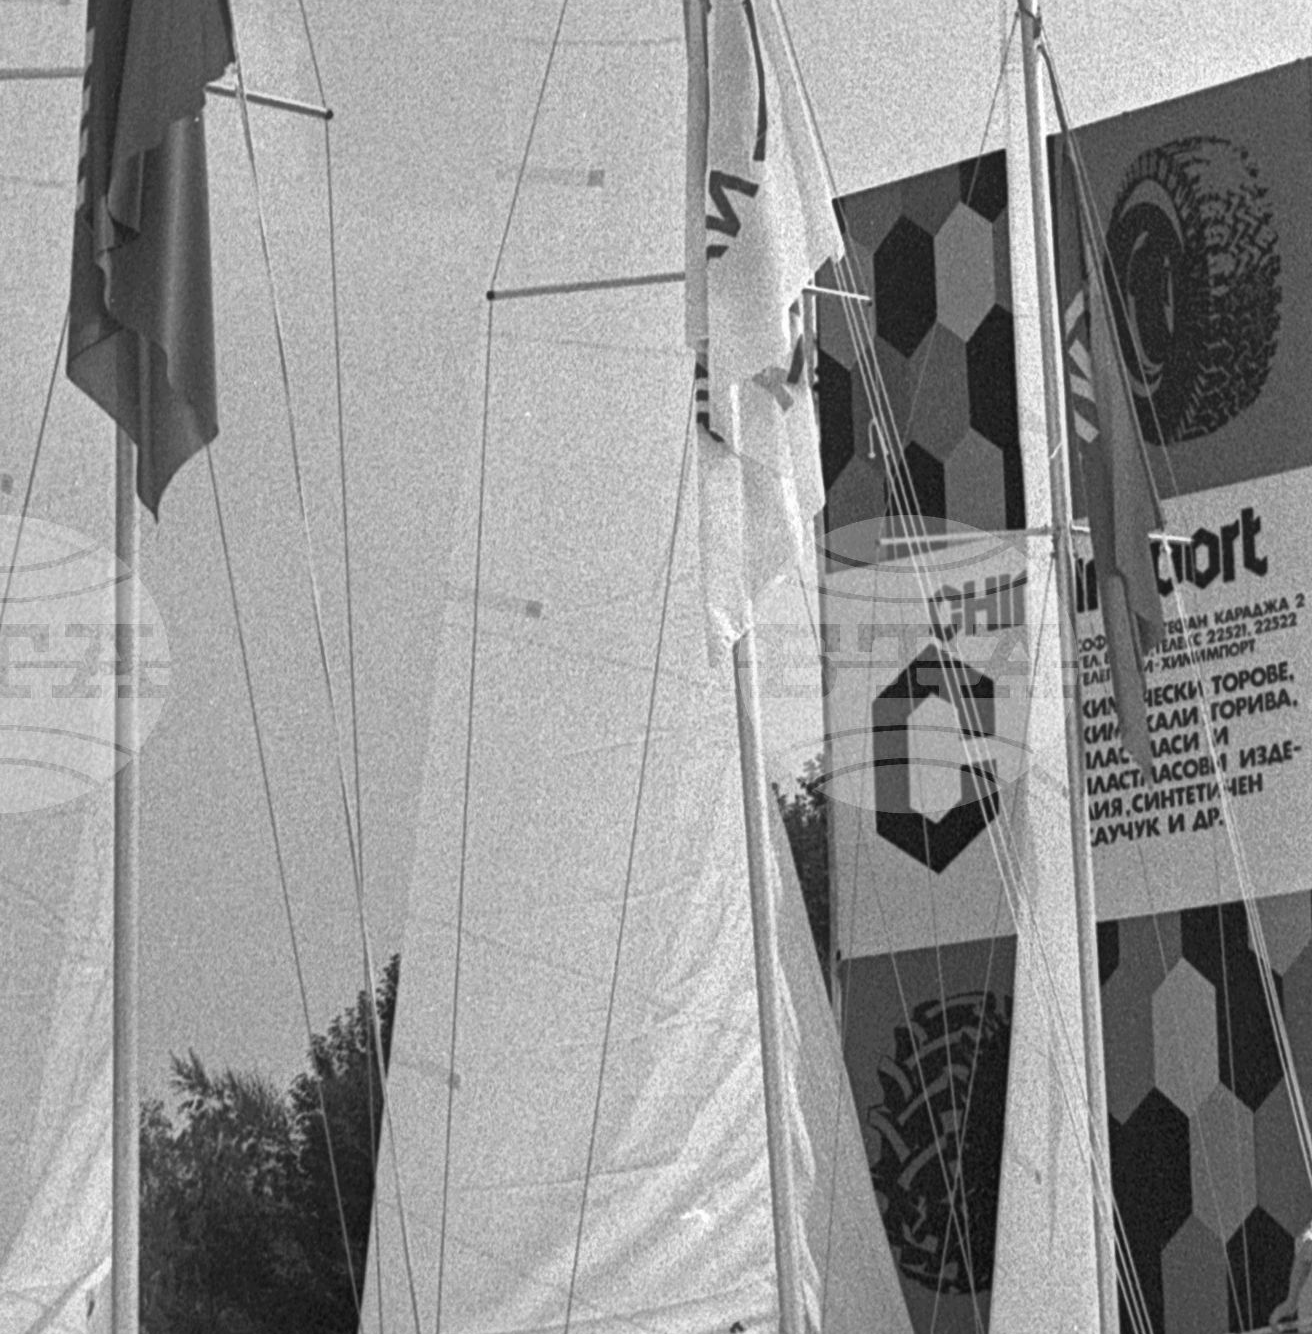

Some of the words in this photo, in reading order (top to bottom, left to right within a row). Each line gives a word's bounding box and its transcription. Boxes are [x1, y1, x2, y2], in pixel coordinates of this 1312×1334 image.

[1214, 597, 1290, 626] КАРАДЖА
[1295, 592, 1305, 609] 2
[1254, 611, 1298, 635] 22522
[1239, 739, 1302, 769] ИЗДЕ-
[1090, 816, 1161, 847] АУЧУК
[1168, 812, 1185, 835] И
[1192, 807, 1225, 832] ДР.
